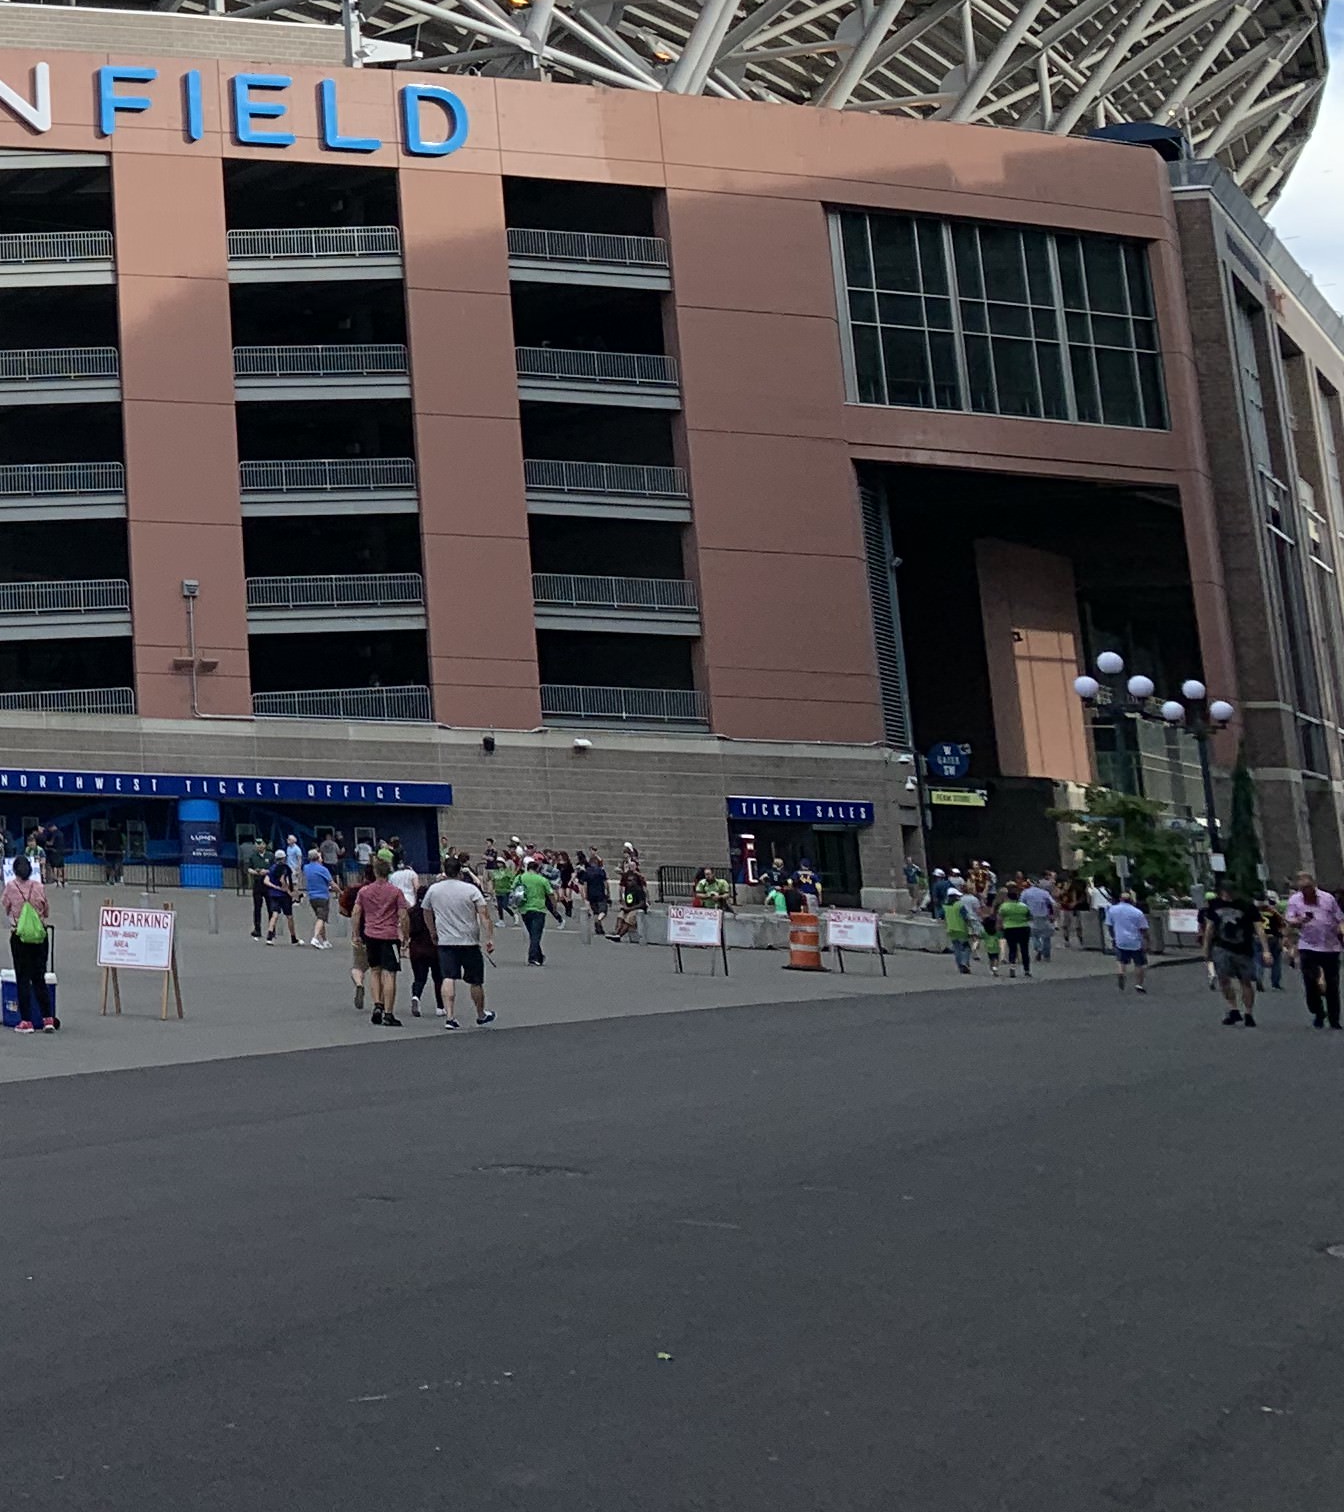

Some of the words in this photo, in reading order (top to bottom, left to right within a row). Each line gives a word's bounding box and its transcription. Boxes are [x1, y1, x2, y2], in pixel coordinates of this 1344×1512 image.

[97, 64, 470, 157] FIELD
[0, 773, 160, 793] NORTHWEST
[185, 779, 281, 796] TICKET
[307, 784, 403, 801] OFFICE
[742, 802, 801, 816] TICKET
[816, 805, 866, 819] SALES
[102, 910, 120, 926] NO
[122, 912, 169, 929] PARKING
